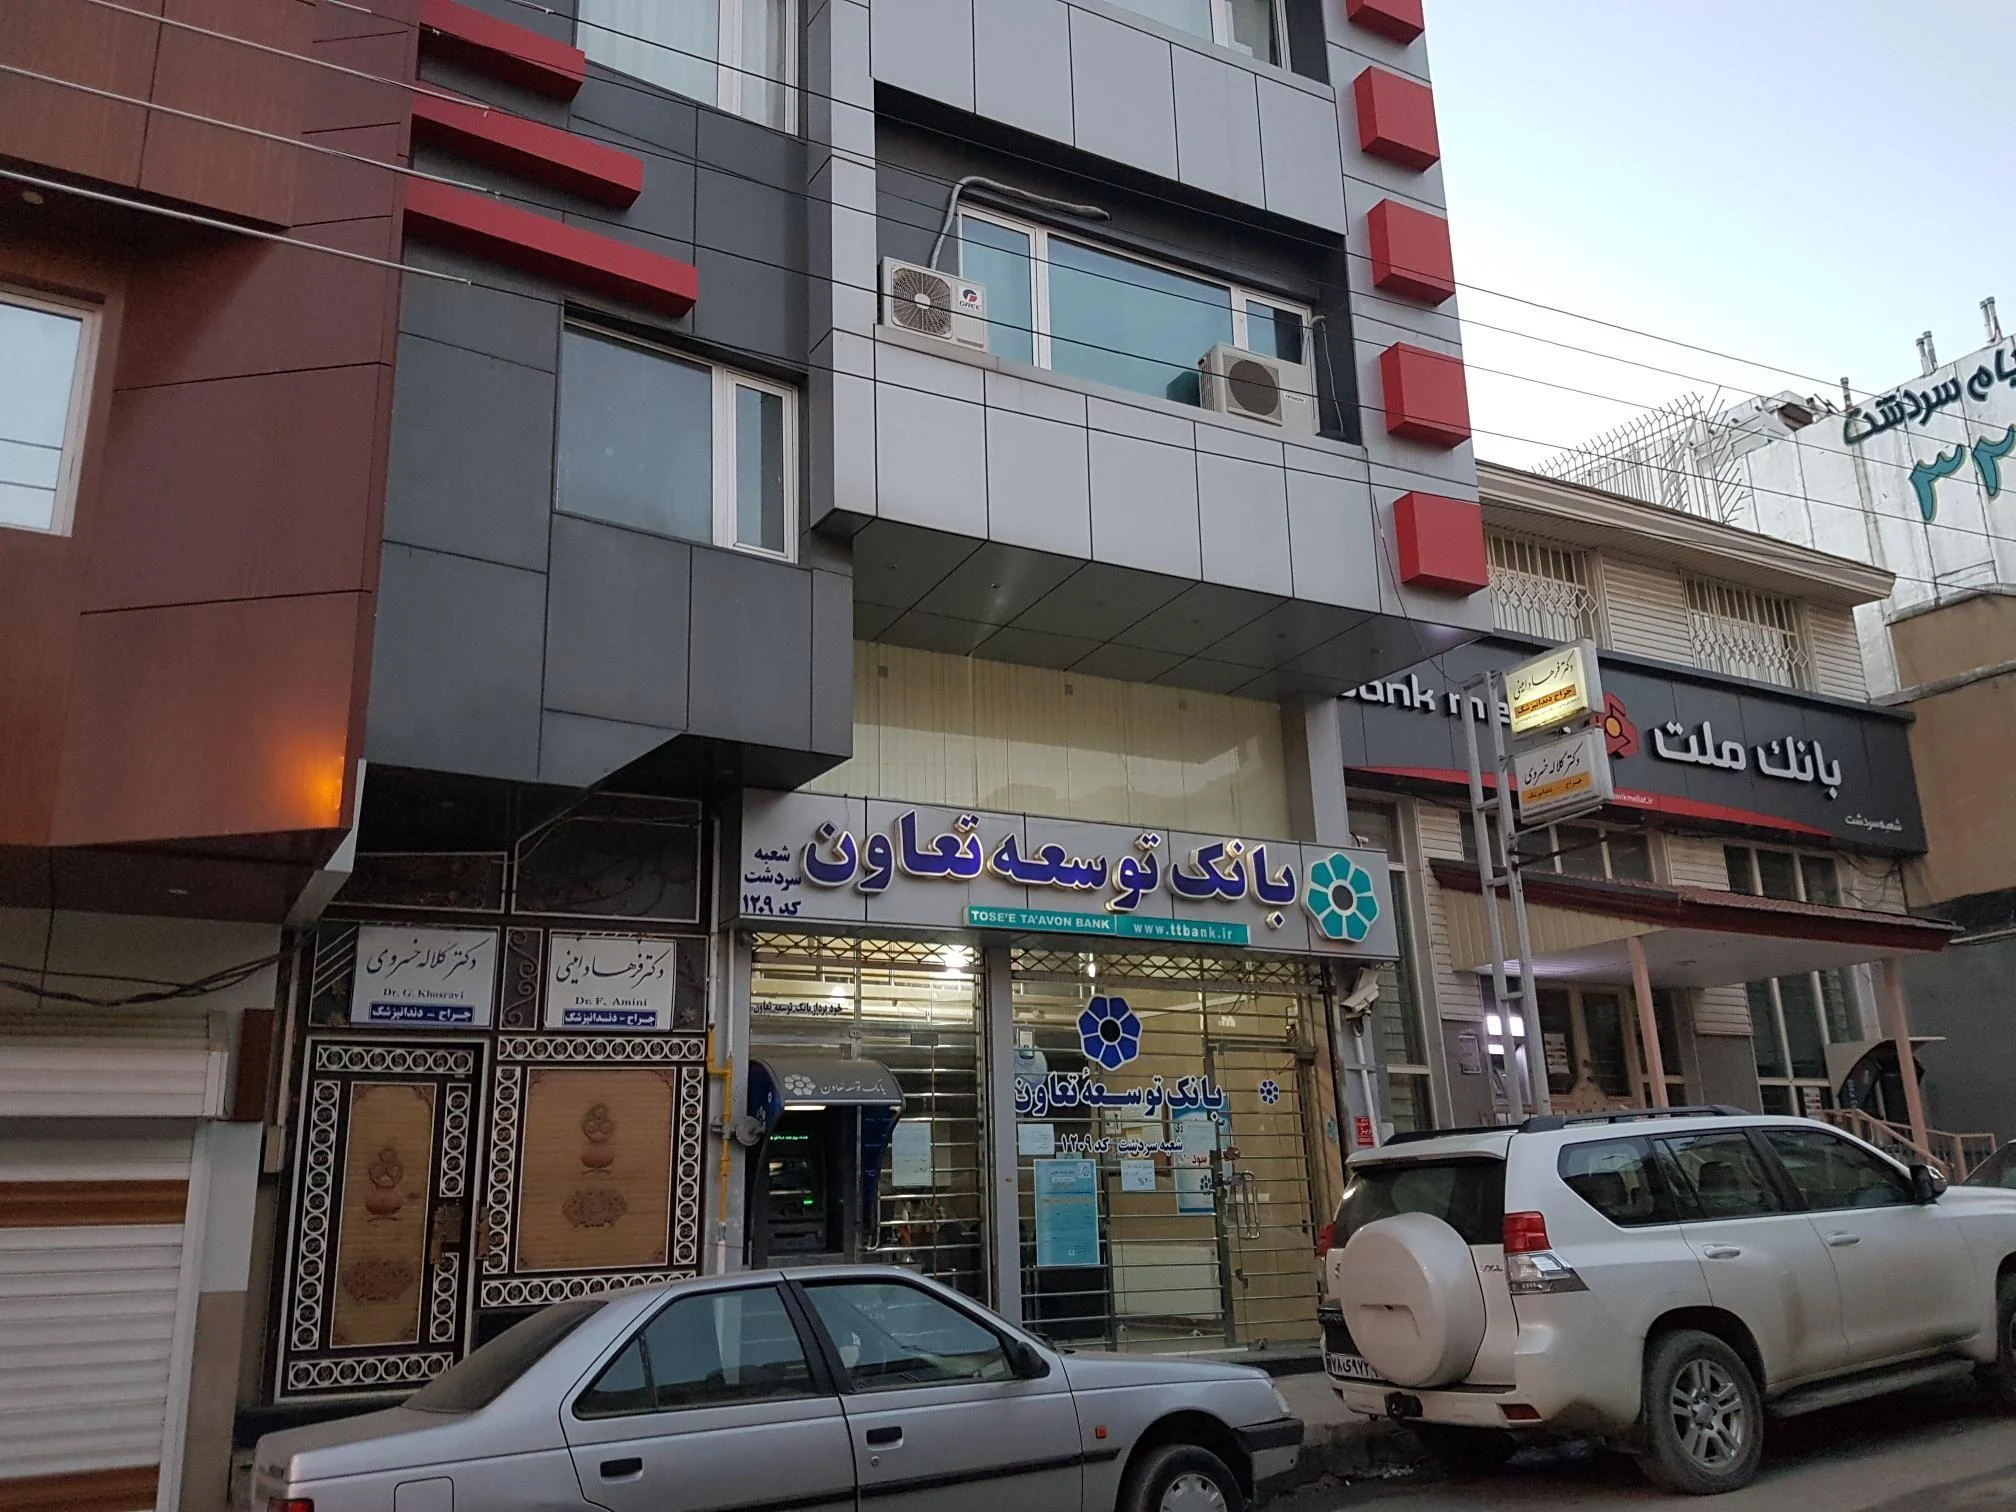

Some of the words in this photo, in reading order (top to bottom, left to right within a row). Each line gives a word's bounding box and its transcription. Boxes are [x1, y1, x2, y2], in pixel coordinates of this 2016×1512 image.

[1844, 377, 1961, 445] سردشت
[1654, 721, 1747, 771] ملت
[1564, 742, 1584, 776] دکتر
[754, 845, 791, 865] شعبه
[801, 810, 984, 895] تعاون
[744, 867, 802, 891] سردشت
[990, 831, 1161, 912] توسعه
[1169, 836, 1297, 928] بانک
[779, 900, 802, 915] کد
[971, 909, 1016, 924] TOSE'E
[1021, 914, 1072, 928] TA'AVON
[1075, 918, 1110, 930] BANK
[1133, 921, 1232, 940] www.ttbank.ir
[366, 938, 420, 979] خسروی
[442, 937, 490, 980] دکتر
[583, 953, 643, 979] فرهاد
[631, 948, 671, 989] دکتر
[418, 989, 464, 1000] Khosravi
[612, 997, 647, 1006] Amini
[438, 1007, 471, 1022] جراح
[627, 1012, 655, 1026] جراح
[1013, 1071, 1079, 1117] تعاون
[1166, 1075, 1225, 1122] بانک
[1093, 1136, 1110, 1152] کد
[1117, 1138, 1159, 1157] سردشت
[1160, 1136, 1184, 1156] شعبه
